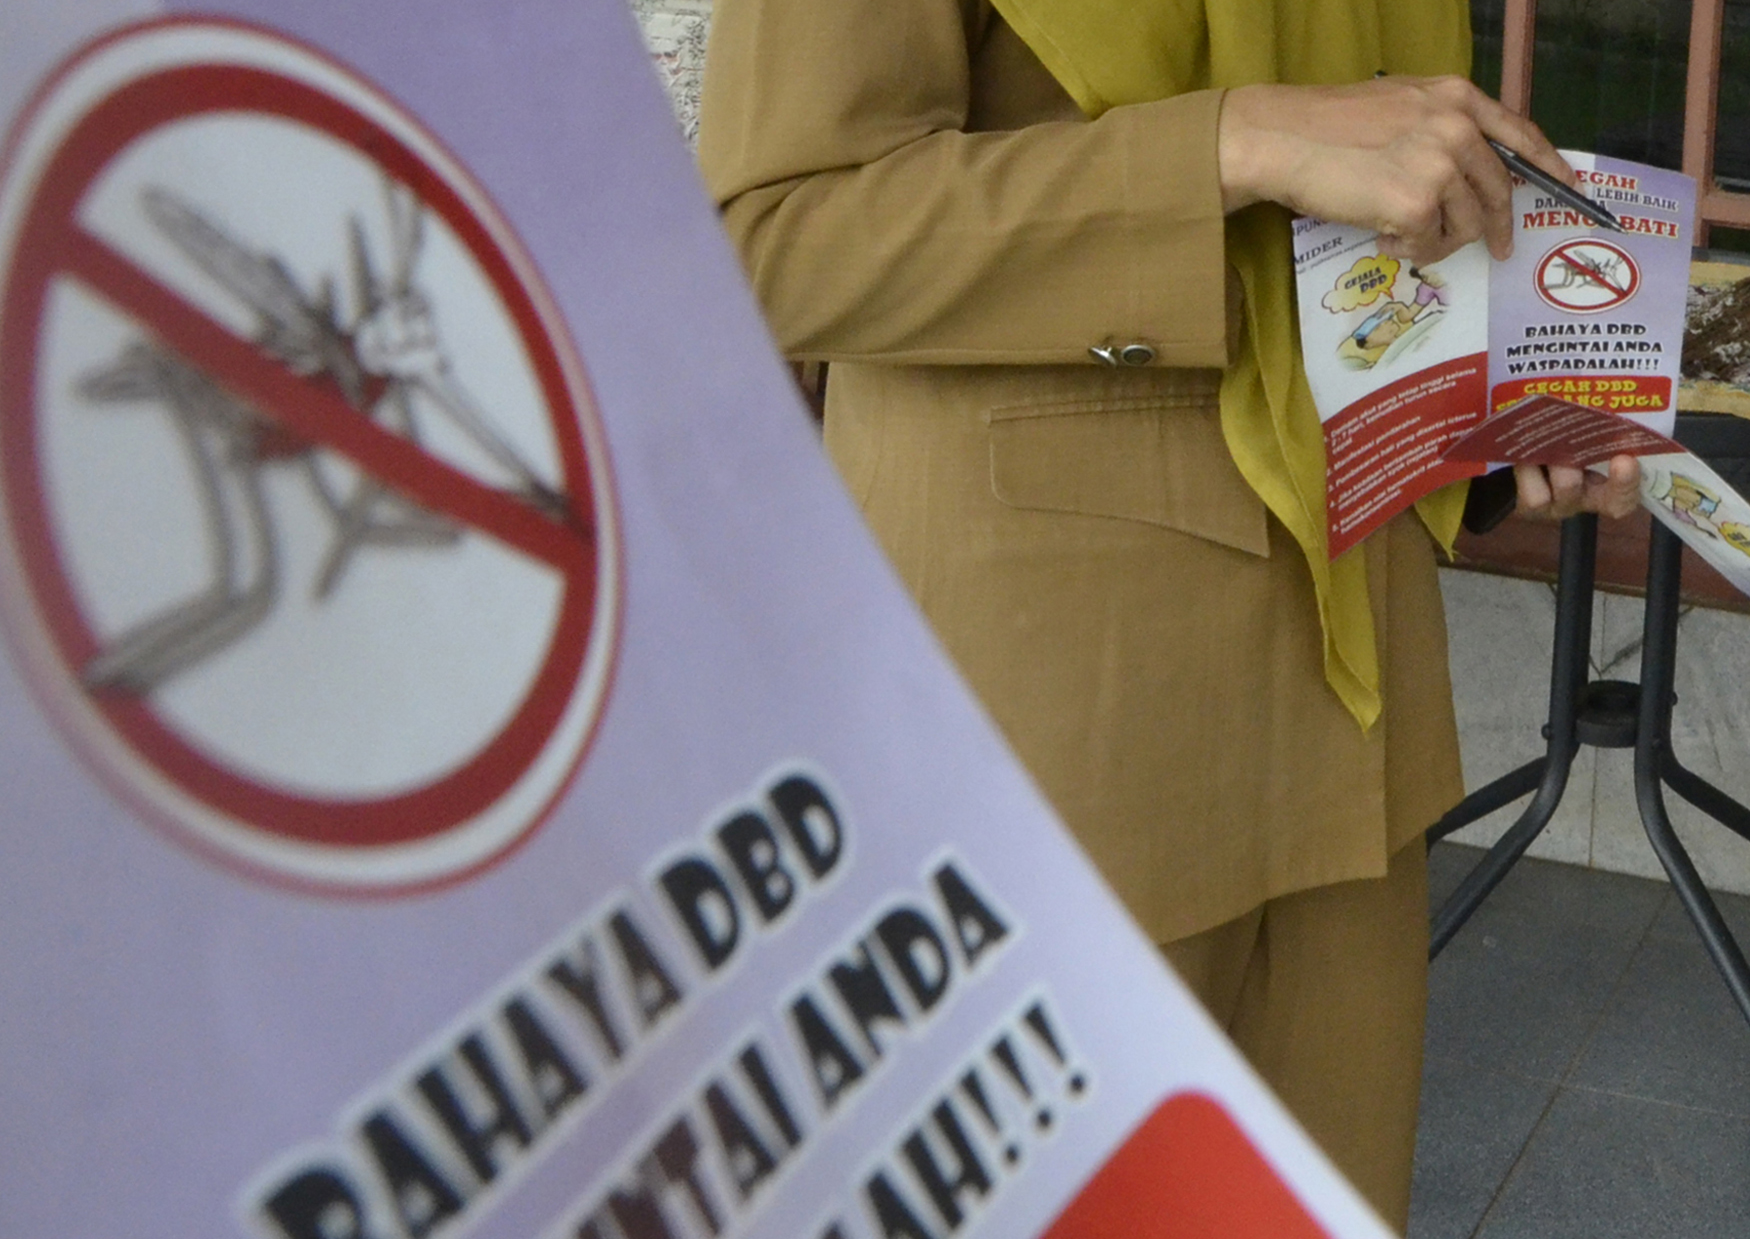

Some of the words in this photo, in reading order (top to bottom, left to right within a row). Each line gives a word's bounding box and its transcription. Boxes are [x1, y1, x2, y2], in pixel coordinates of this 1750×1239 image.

[1596, 188, 1639, 203] LEBIH
[1643, 196, 1677, 211] BAIK
[1344, 267, 1381, 290] GEJALA
[1360, 274, 1387, 293] DBD
[1525, 324, 1602, 338] BAHAYA
[1607, 323, 1646, 335] DBD
[1506, 342, 1609, 358] MENGINTAI
[1614, 341, 1662, 353] ANDA
[1524, 380, 1591, 395] CEGAH
[1595, 380, 1637, 392] DBD
[1609, 395, 1663, 409] JUGA
[658, 769, 850, 971] DBD
[574, 1040, 803, 1239] NTAI
[791, 862, 1012, 1108] ANDA
[822, 1001, 1086, 1239] AH!!!
